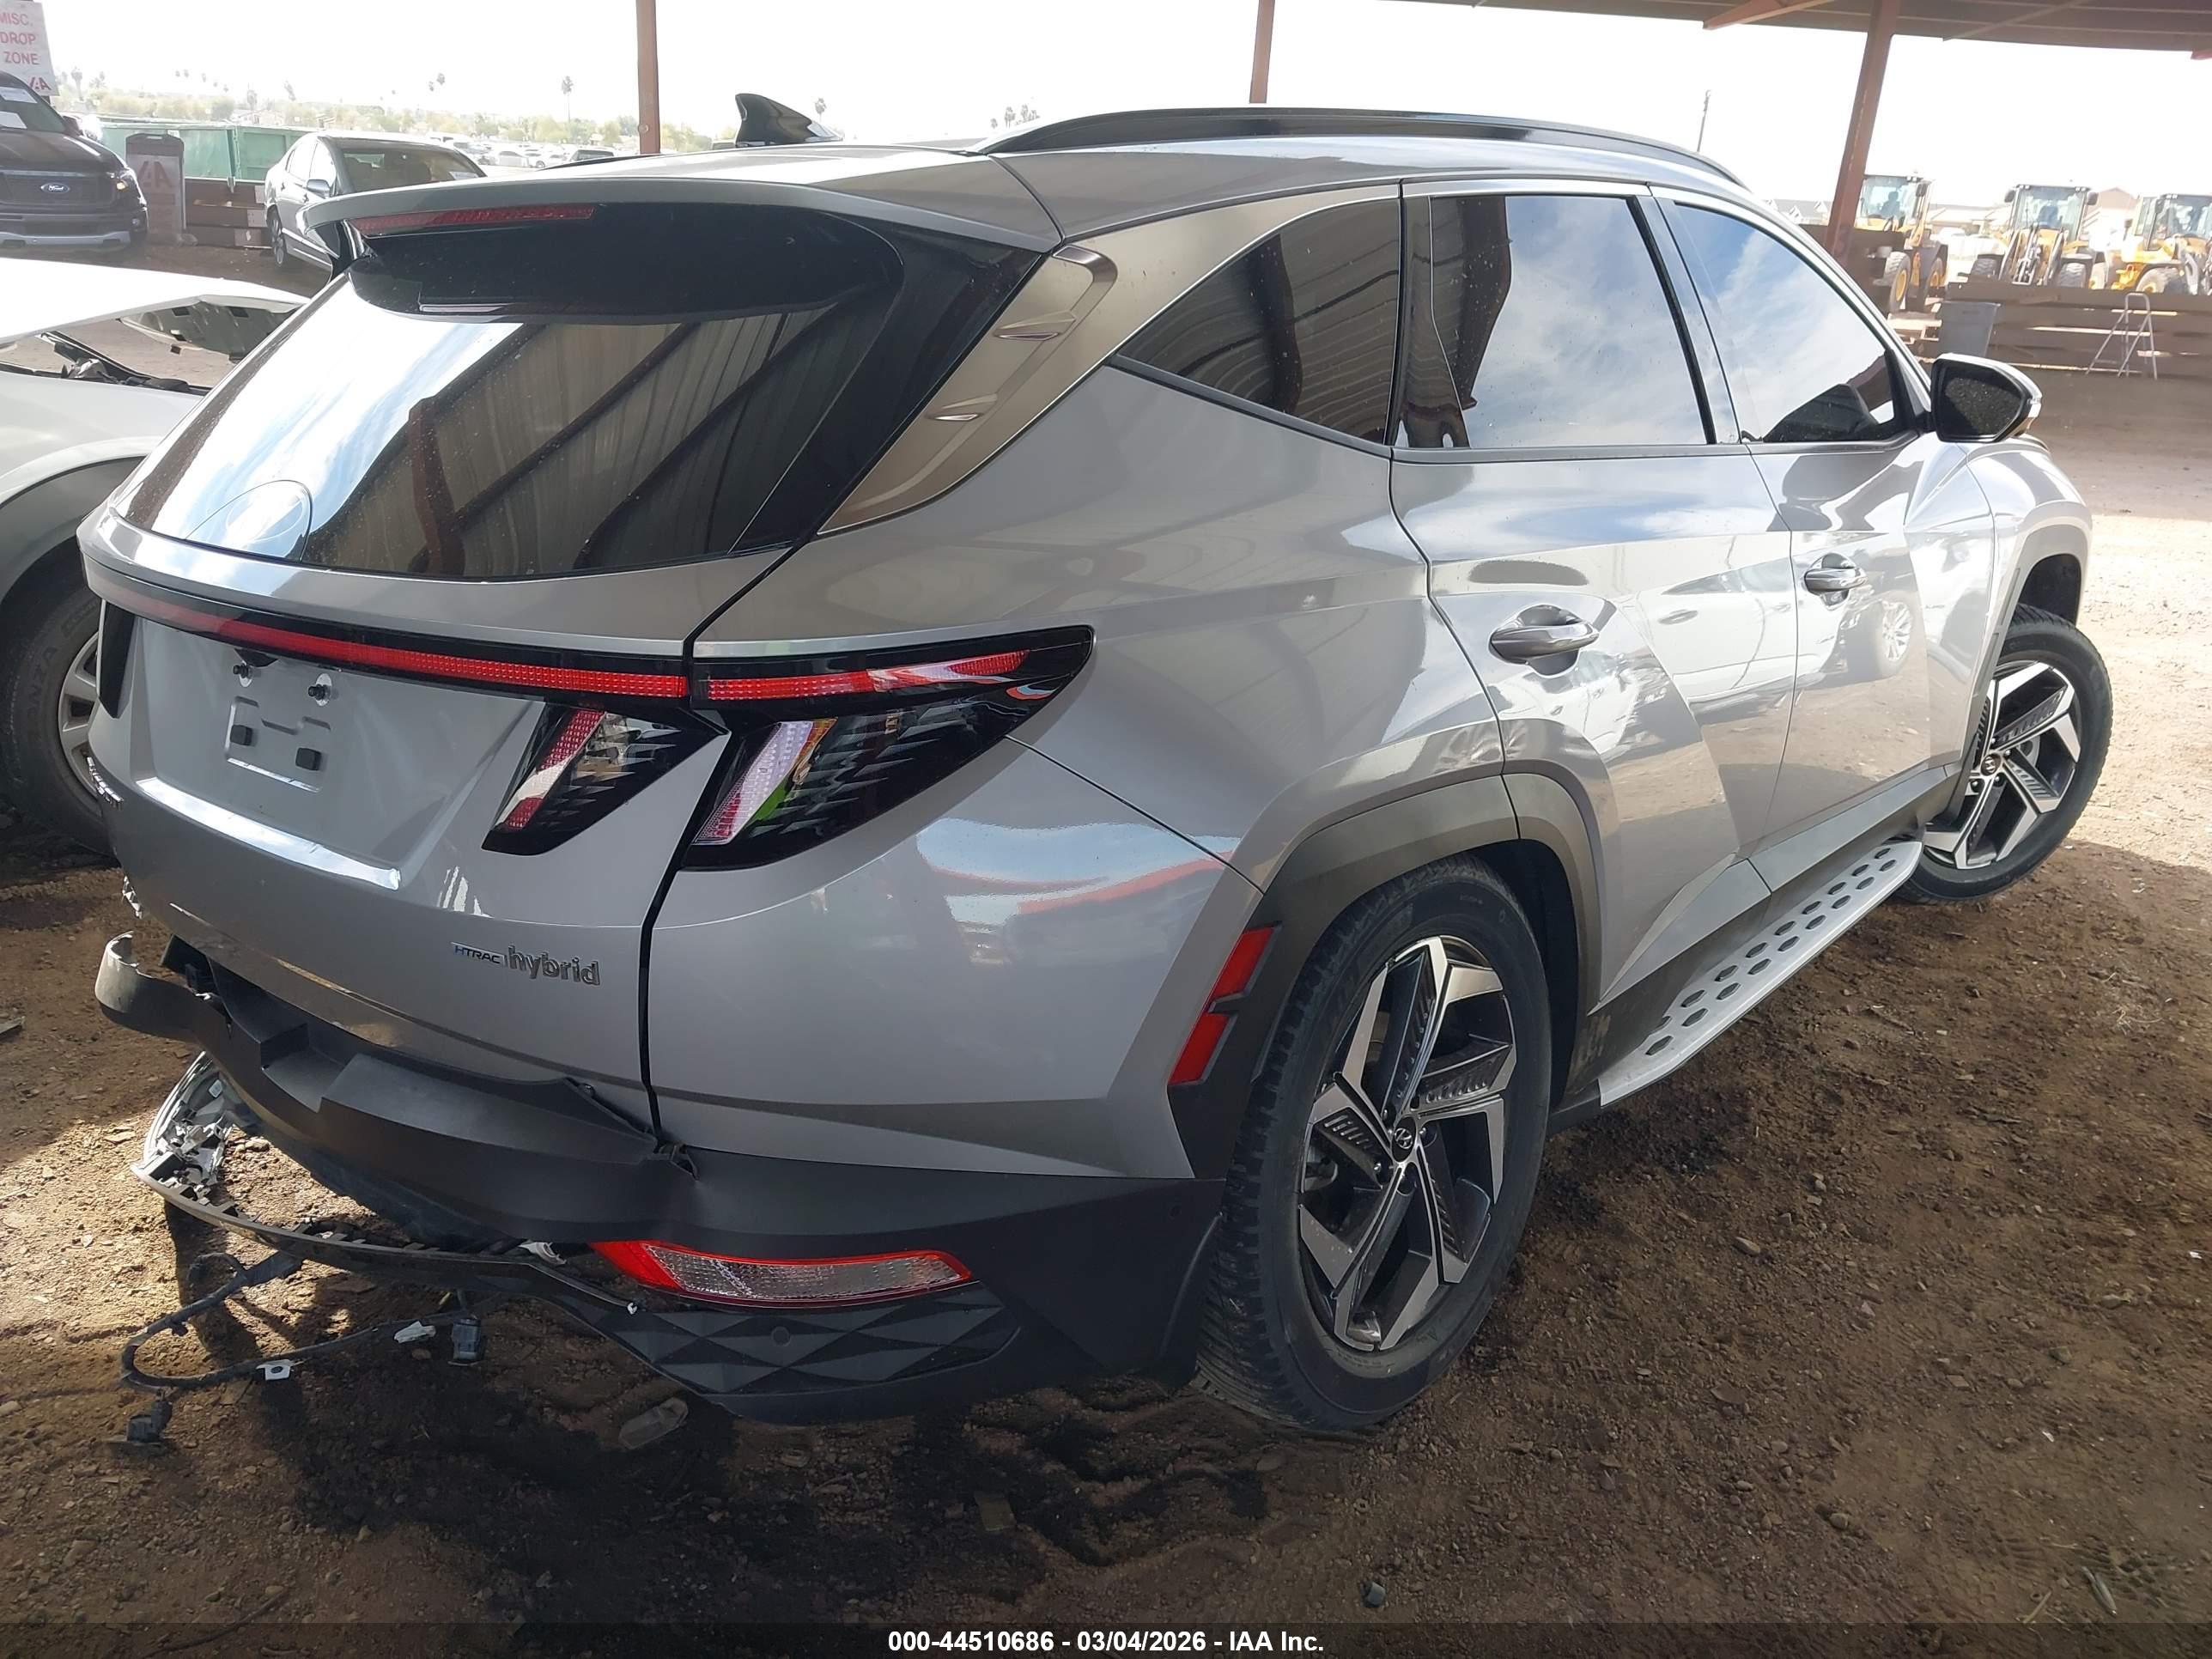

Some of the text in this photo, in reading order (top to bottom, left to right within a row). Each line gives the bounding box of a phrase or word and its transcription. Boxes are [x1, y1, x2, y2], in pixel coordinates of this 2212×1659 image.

[0, 31, 36, 46] DROP
[3, 51, 40, 65] ZONE
[454, 945, 601, 986] HTRAC hybrid
